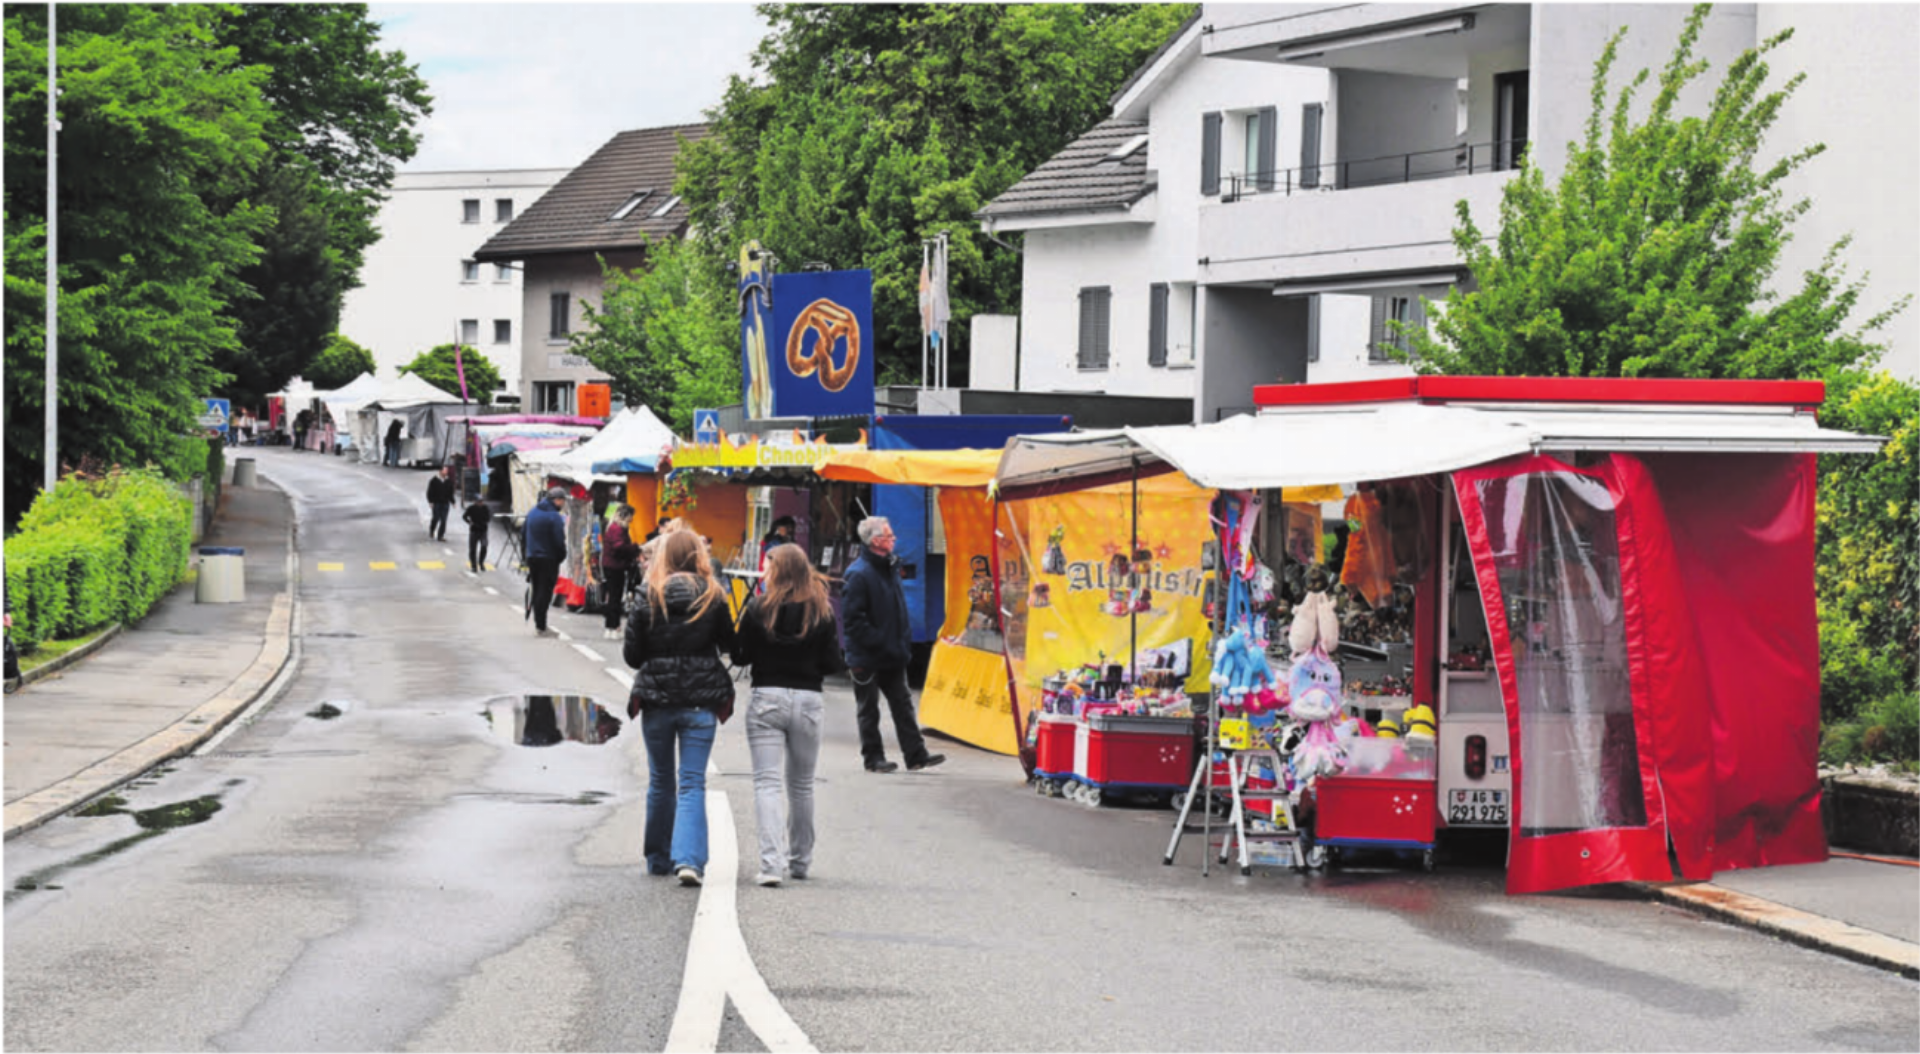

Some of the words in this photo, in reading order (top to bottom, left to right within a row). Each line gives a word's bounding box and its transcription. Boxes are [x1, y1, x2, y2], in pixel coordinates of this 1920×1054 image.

[1472, 791, 1487, 803] AG
[1452, 805, 1476, 820] 291
[1480, 805, 1506, 820] 975
